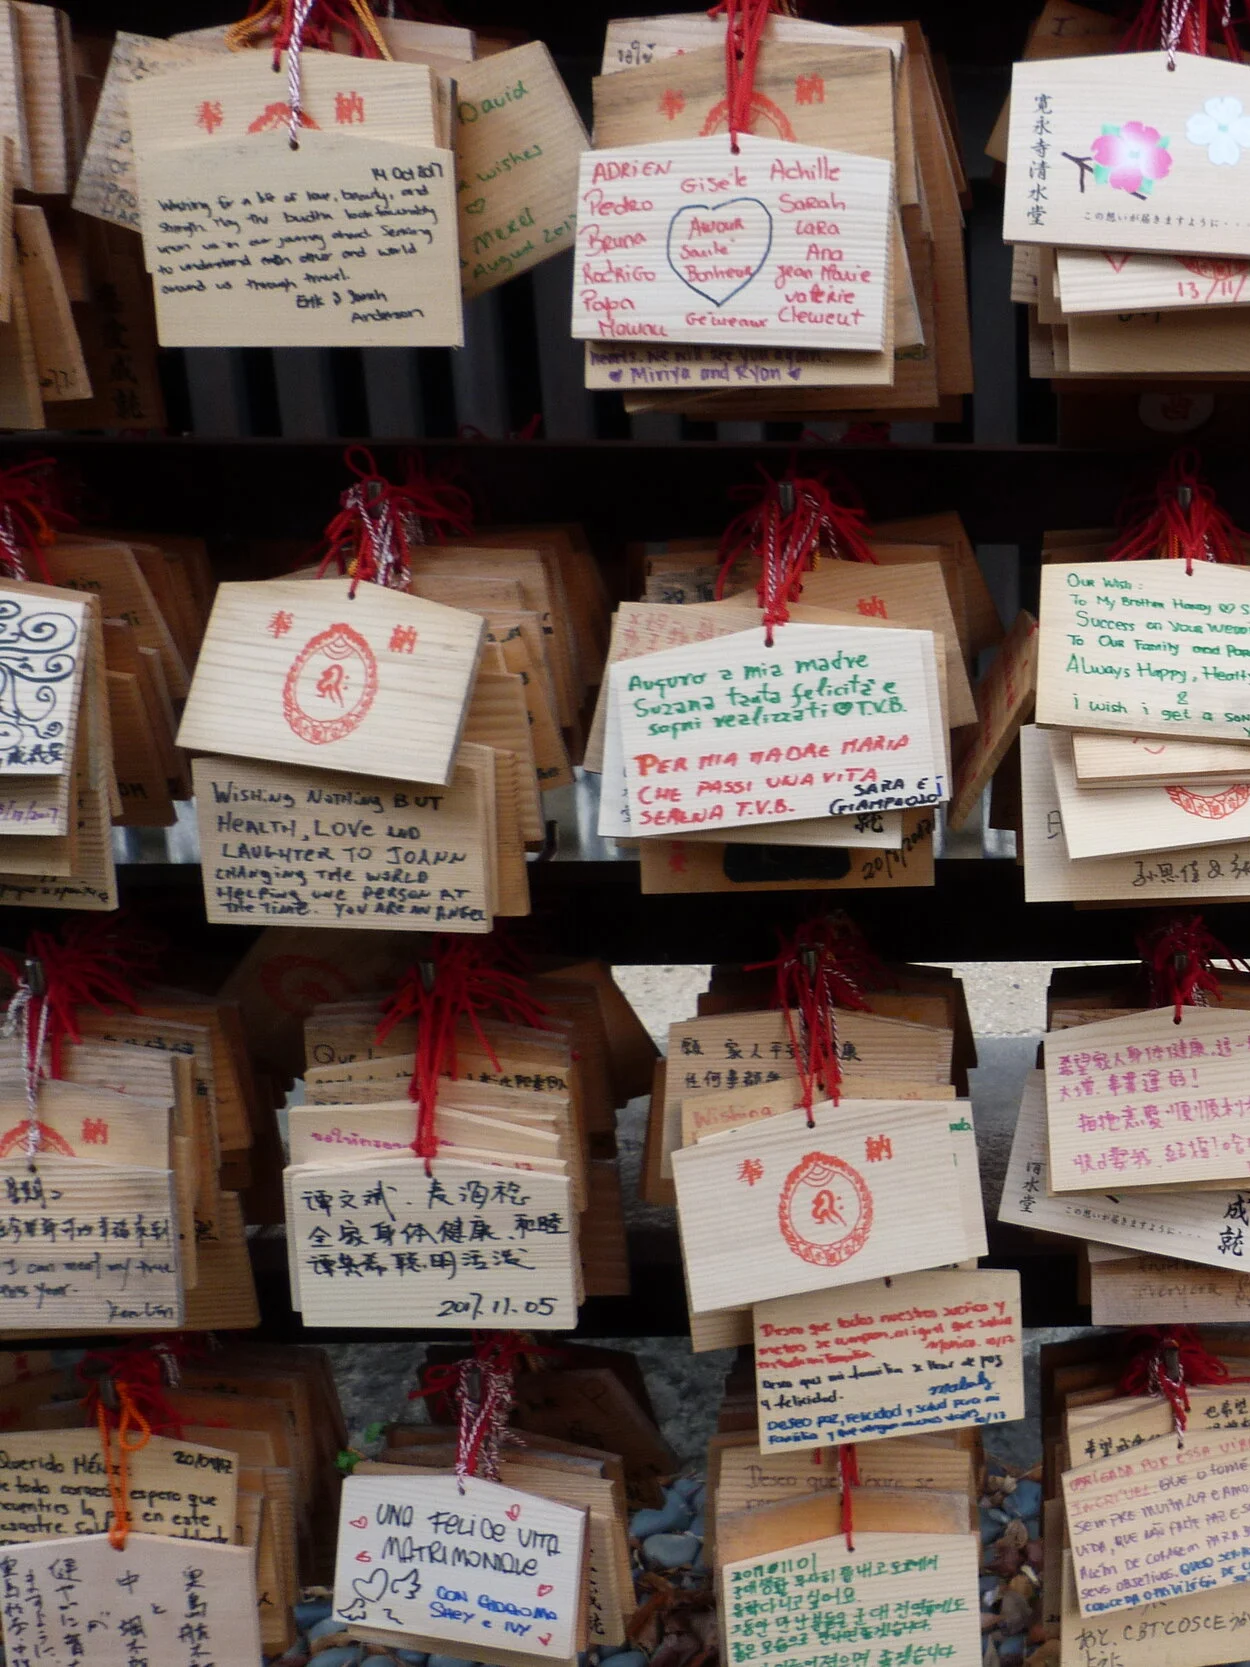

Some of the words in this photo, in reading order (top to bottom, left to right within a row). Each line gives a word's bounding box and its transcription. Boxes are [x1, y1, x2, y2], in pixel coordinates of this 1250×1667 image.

[769, 156, 841, 182] Achille
[806, 243, 844, 261] Ana
[351, 309, 425, 323] Anderson
[701, 362, 729, 381] and
[1096, 595, 1116, 610] My
[266, 610, 294, 639] 奉
[1076, 610, 1135, 632] Success
[388, 624, 419, 654] 納
[628, 672, 708, 698] Auguro
[743, 664, 784, 680] mia
[795, 650, 869, 674] madre
[1137, 661, 1198, 683] Happy,
[634, 696, 715, 718] Suzana
[726, 684, 781, 707] tanta
[1089, 699, 1128, 714] wish
[1161, 707, 1190, 722] get
[647, 718, 702, 740] sogni
[713, 702, 828, 729] realizzati
[634, 753, 689, 777] PER
[698, 752, 738, 770] MIA
[749, 743, 831, 765] MADRE
[841, 734, 910, 755] MARIA
[637, 785, 682, 806] CHE
[696, 779, 753, 797] PASSI
[766, 772, 814, 789] UNA
[854, 779, 904, 796] SARA
[394, 795, 445, 811] BUT
[639, 804, 724, 825] SERENA
[342, 846, 372, 861] TO
[864, 1134, 893, 1162] 納
[737, 1158, 765, 1187] 奉
[15, 1476, 51, 1494] todo
[130, 1490, 181, 1508] espero
[188, 1494, 217, 1510] que
[172, 1508, 211, 1528] este
